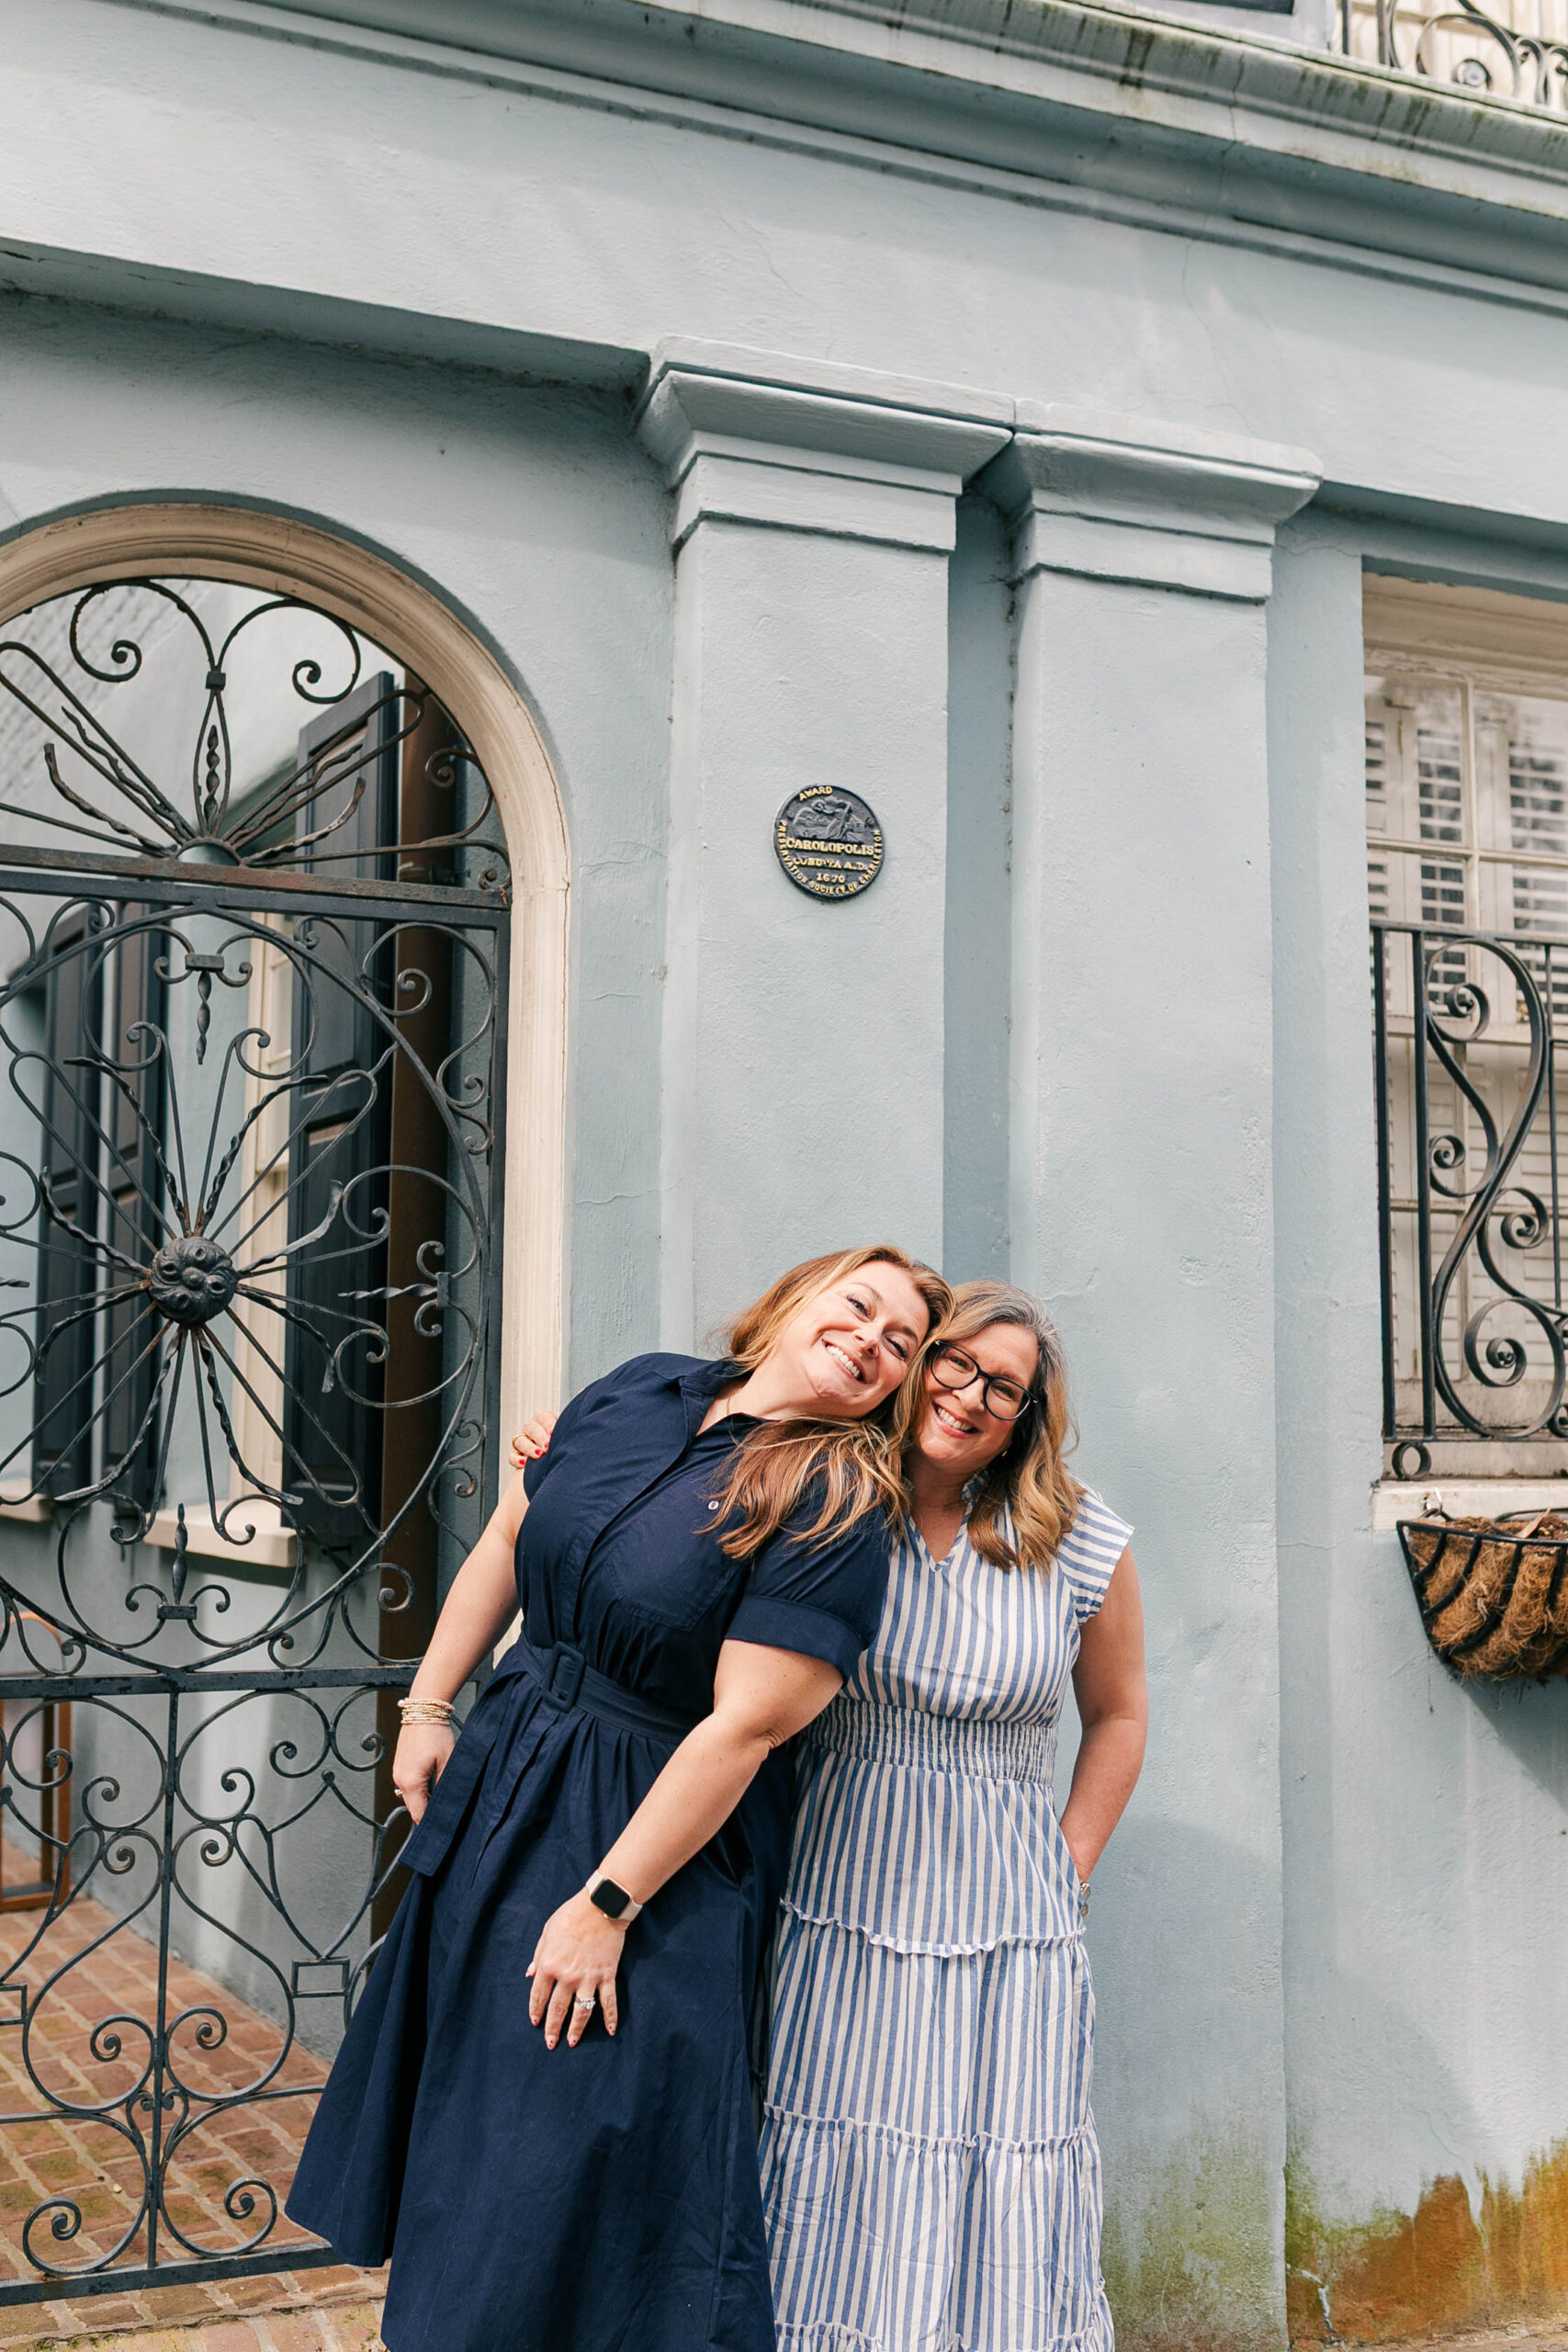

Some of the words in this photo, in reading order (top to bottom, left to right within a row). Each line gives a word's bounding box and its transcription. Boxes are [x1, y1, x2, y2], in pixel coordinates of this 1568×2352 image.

[799, 786, 833, 801] AWARD
[785, 838, 874, 856] CAROLOPOLIS
[816, 873, 846, 883] 1670
[809, 880, 846, 895] SOCIETY
[848, 882, 859, 893] OF
